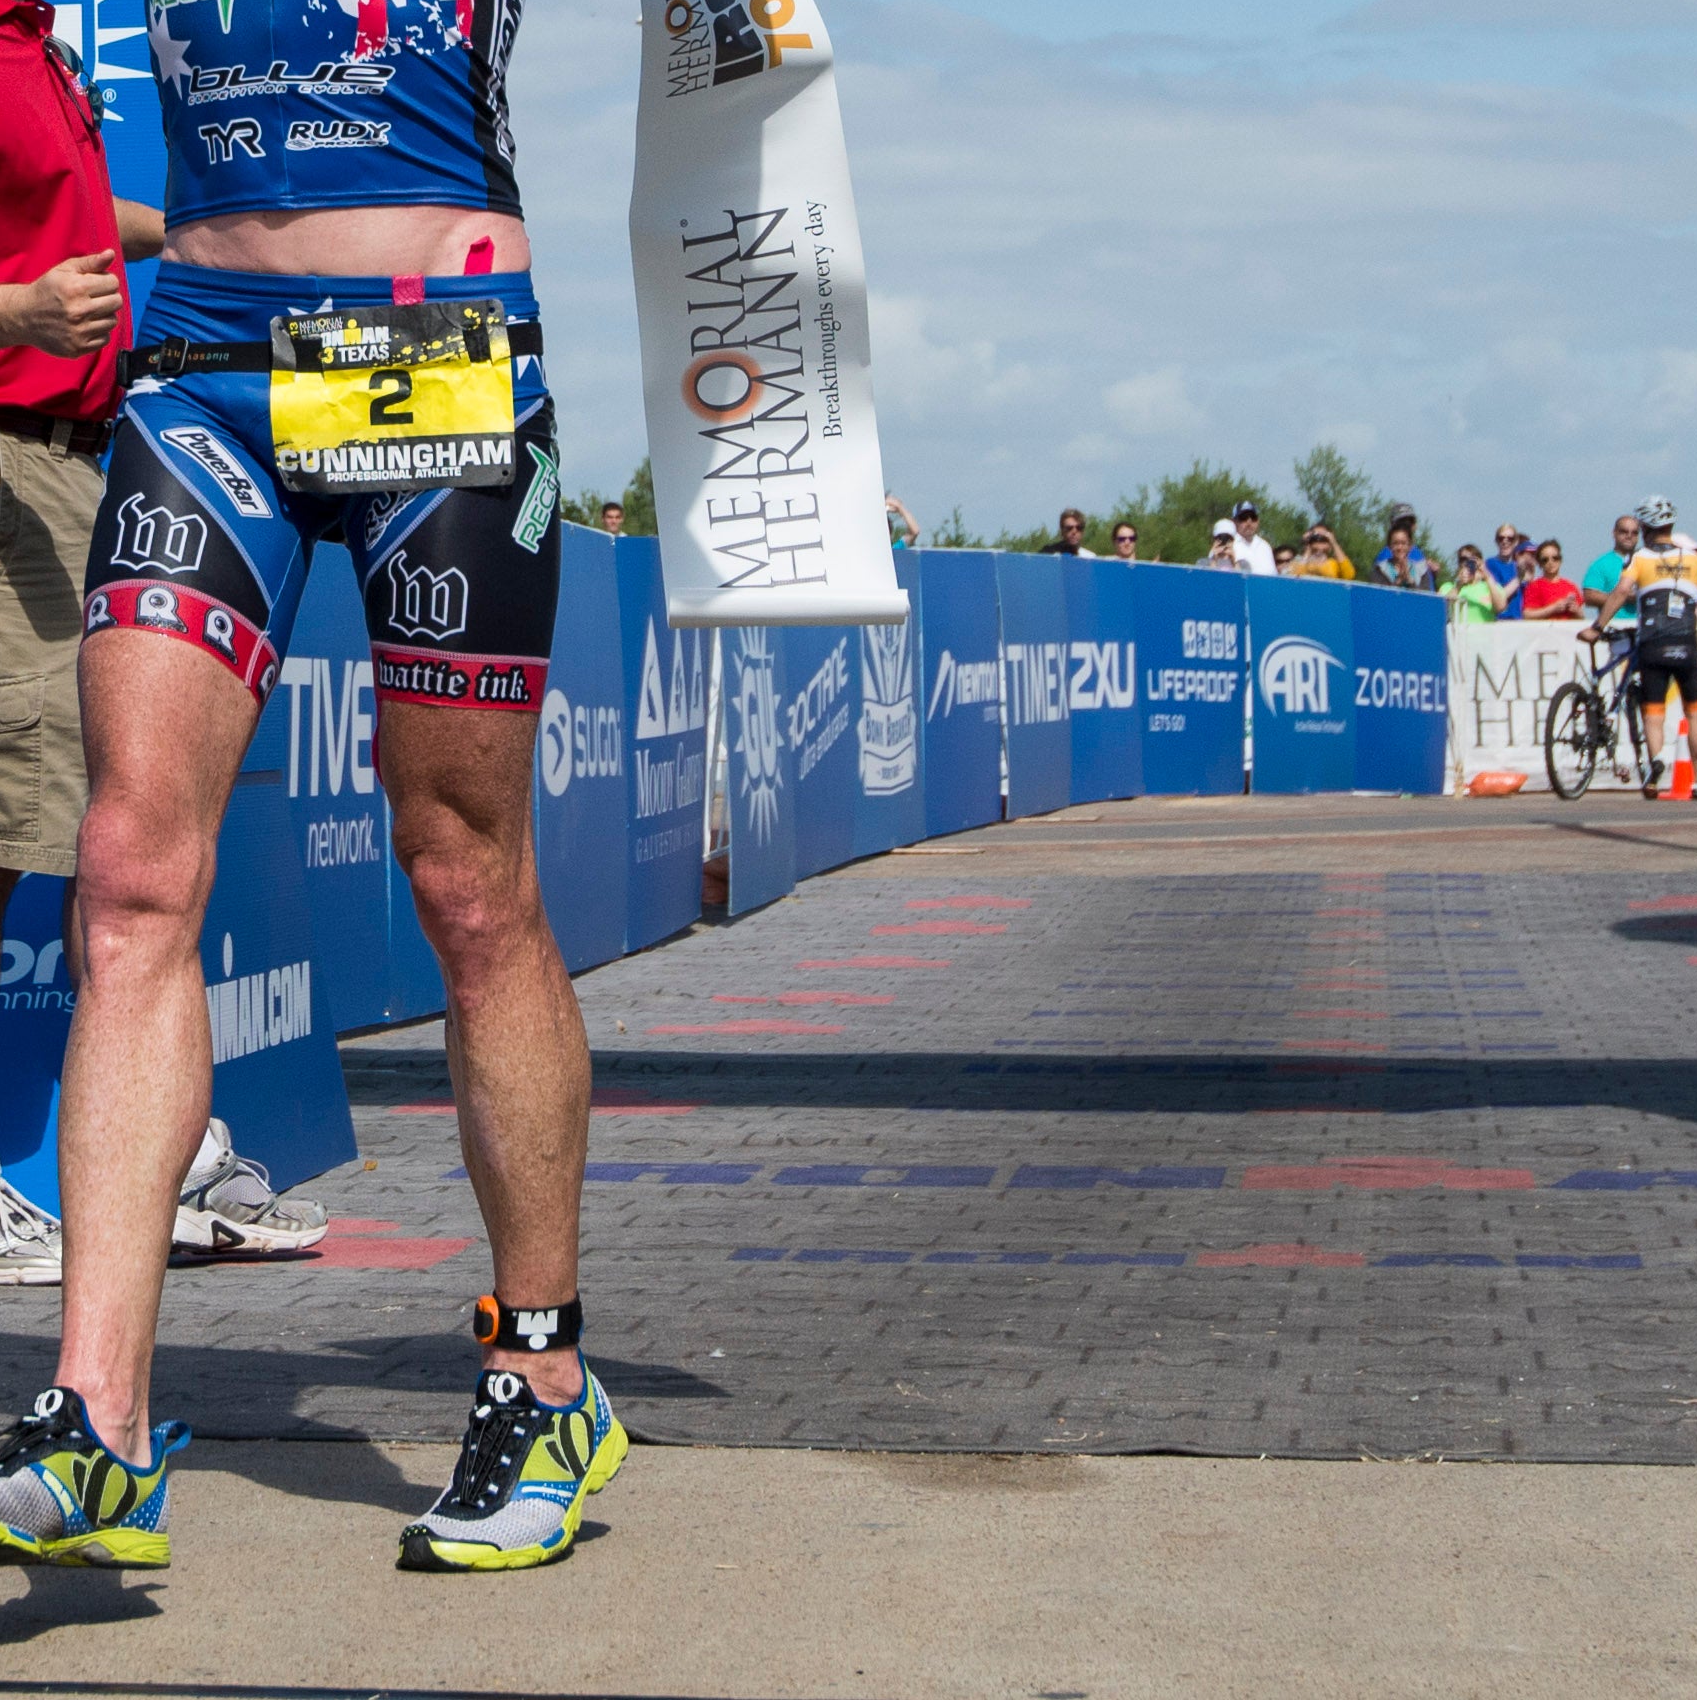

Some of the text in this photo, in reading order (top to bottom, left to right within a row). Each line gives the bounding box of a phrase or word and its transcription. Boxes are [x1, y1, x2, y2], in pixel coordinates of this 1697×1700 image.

[200, 117, 392, 164] TYR RUDY
[804, 198, 843, 440] Breakthroughs every day
[338, 344, 390, 363] TEXAS
[368, 369, 414, 426] 2
[680, 208, 774, 589] MEMORIAL
[736, 207, 828, 587] HERMANN
[176, 432, 260, 510] PowerBar
[278, 439, 513, 473] CUNNINGHAM
[327, 466, 462, 483] PROFESSIONAL ATHLETE
[378, 657, 530, 701] wattie ink.
[1007, 641, 1070, 726] TIMEX
[1069, 640, 1136, 710] 2XU
[1147, 668, 1239, 703] LIFEPROOF
[1355, 666, 1446, 713] ZORREL
[279, 657, 375, 798] TIVE
[742, 666, 778, 779] GU
[307, 814, 375, 868] network
